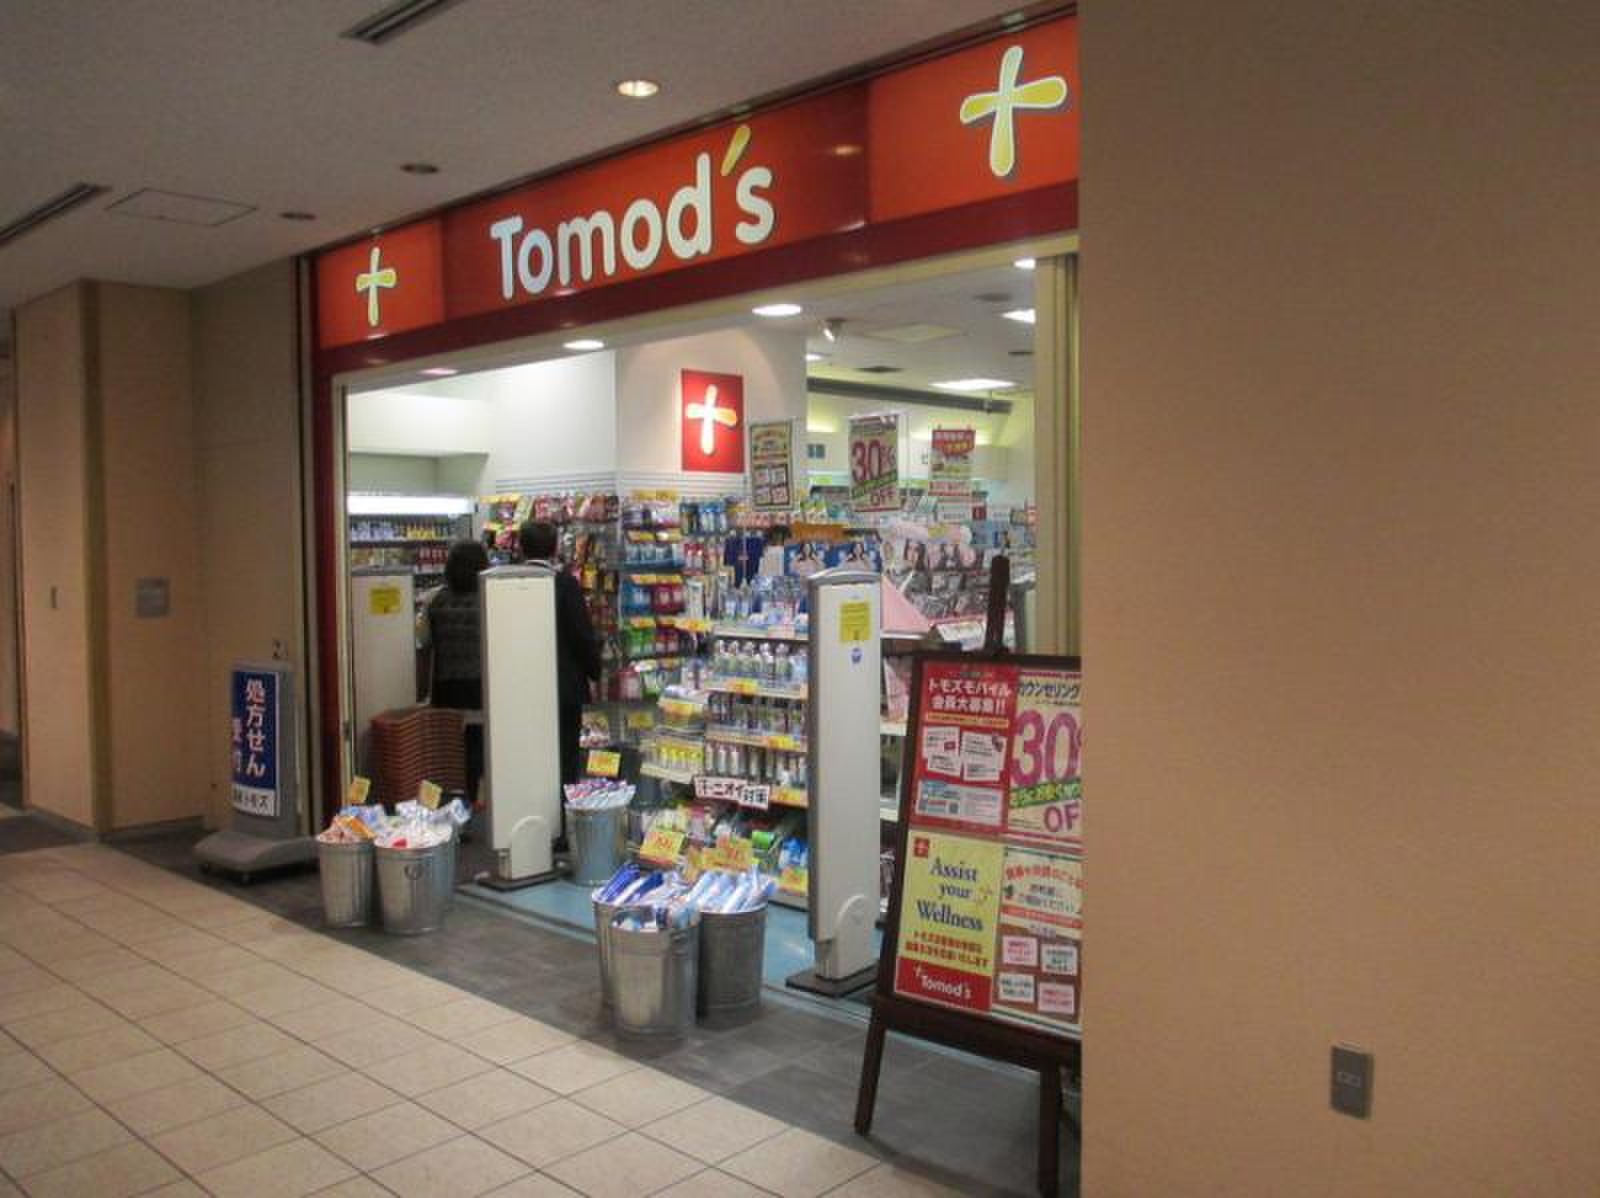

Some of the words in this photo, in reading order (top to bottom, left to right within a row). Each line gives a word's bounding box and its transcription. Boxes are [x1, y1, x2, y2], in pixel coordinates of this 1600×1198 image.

[490, 123, 776, 300] Tomod's
[928, 678, 1012, 698] トモズモバイル
[245, 678, 266, 778] 処方せん
[1012, 709, 1081, 787] 30
[930, 857, 979, 882] Assist
[938, 883, 972, 899] your
[917, 899, 984, 932] Wellness
[921, 974, 972, 1000] Tomod's
